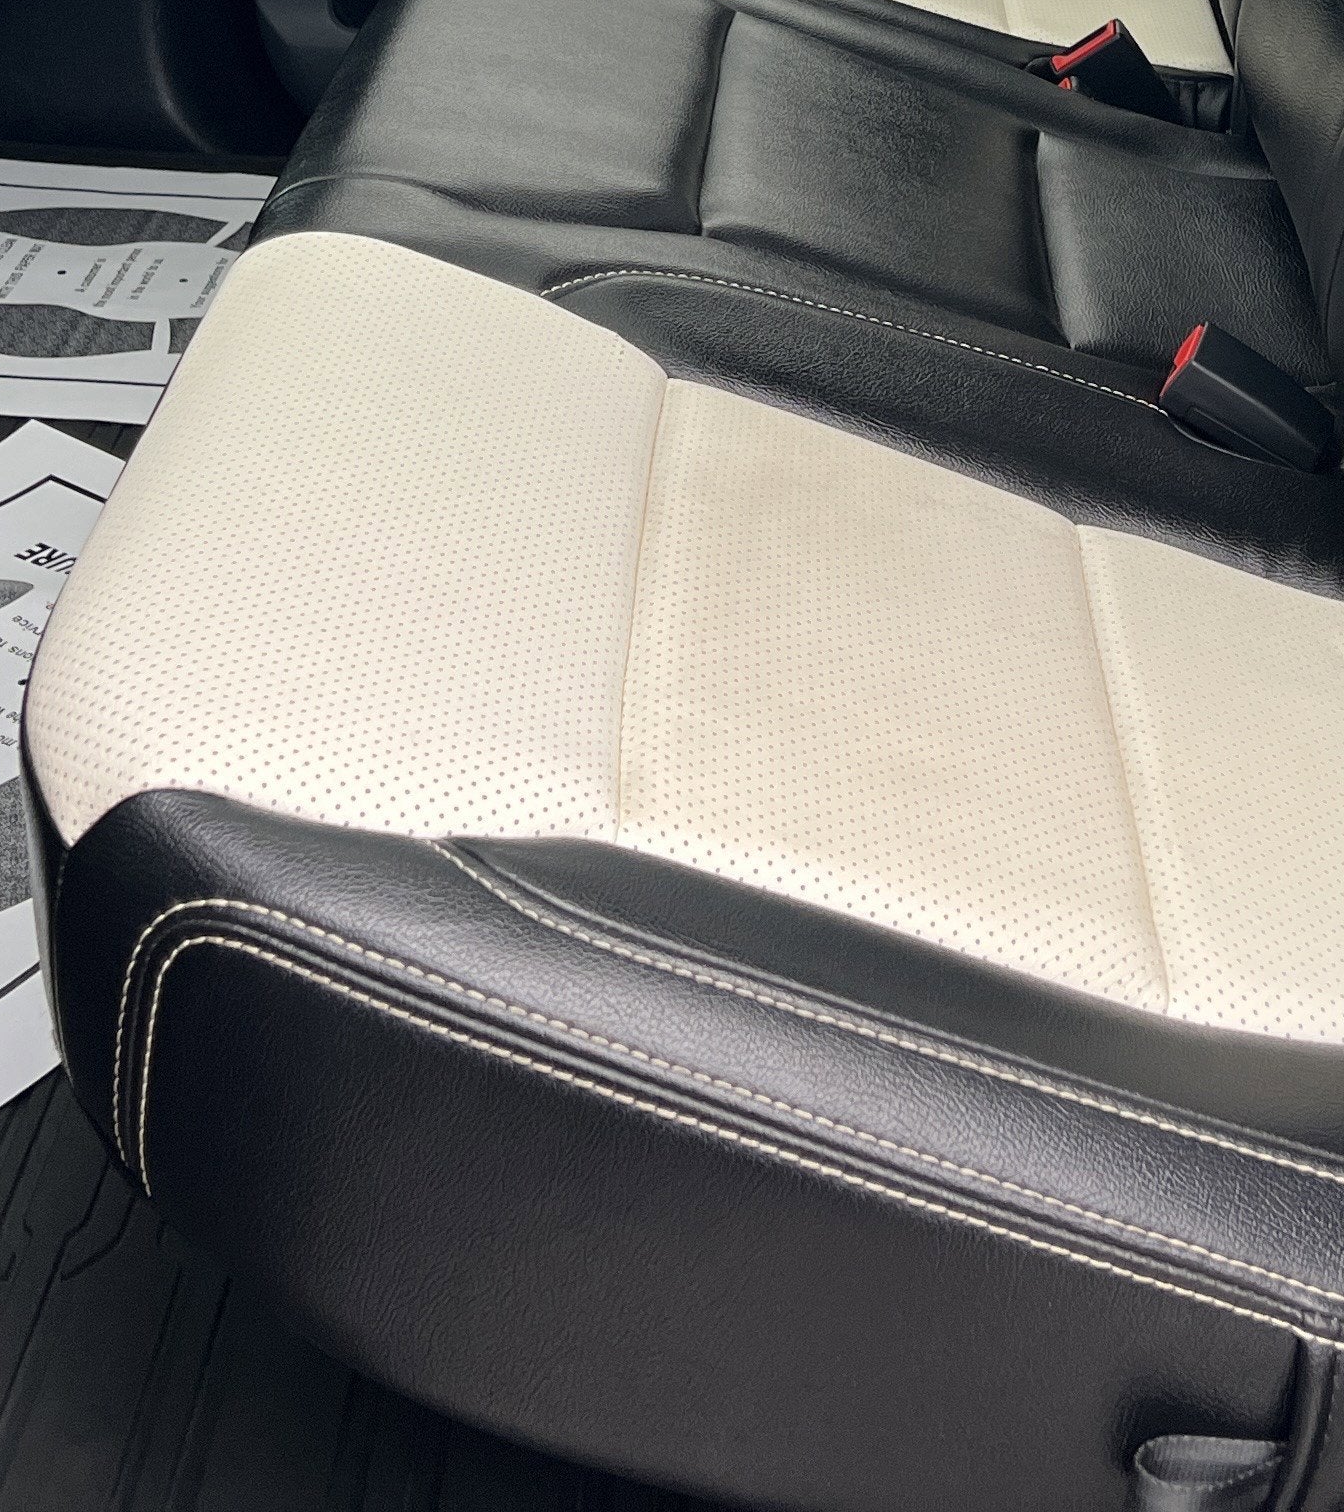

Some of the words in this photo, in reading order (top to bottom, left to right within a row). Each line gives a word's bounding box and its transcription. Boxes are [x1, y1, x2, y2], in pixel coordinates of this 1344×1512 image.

[13, 542, 77, 575] URE
[12, 615, 43, 636] rvice
[6, 712, 24, 724] he
